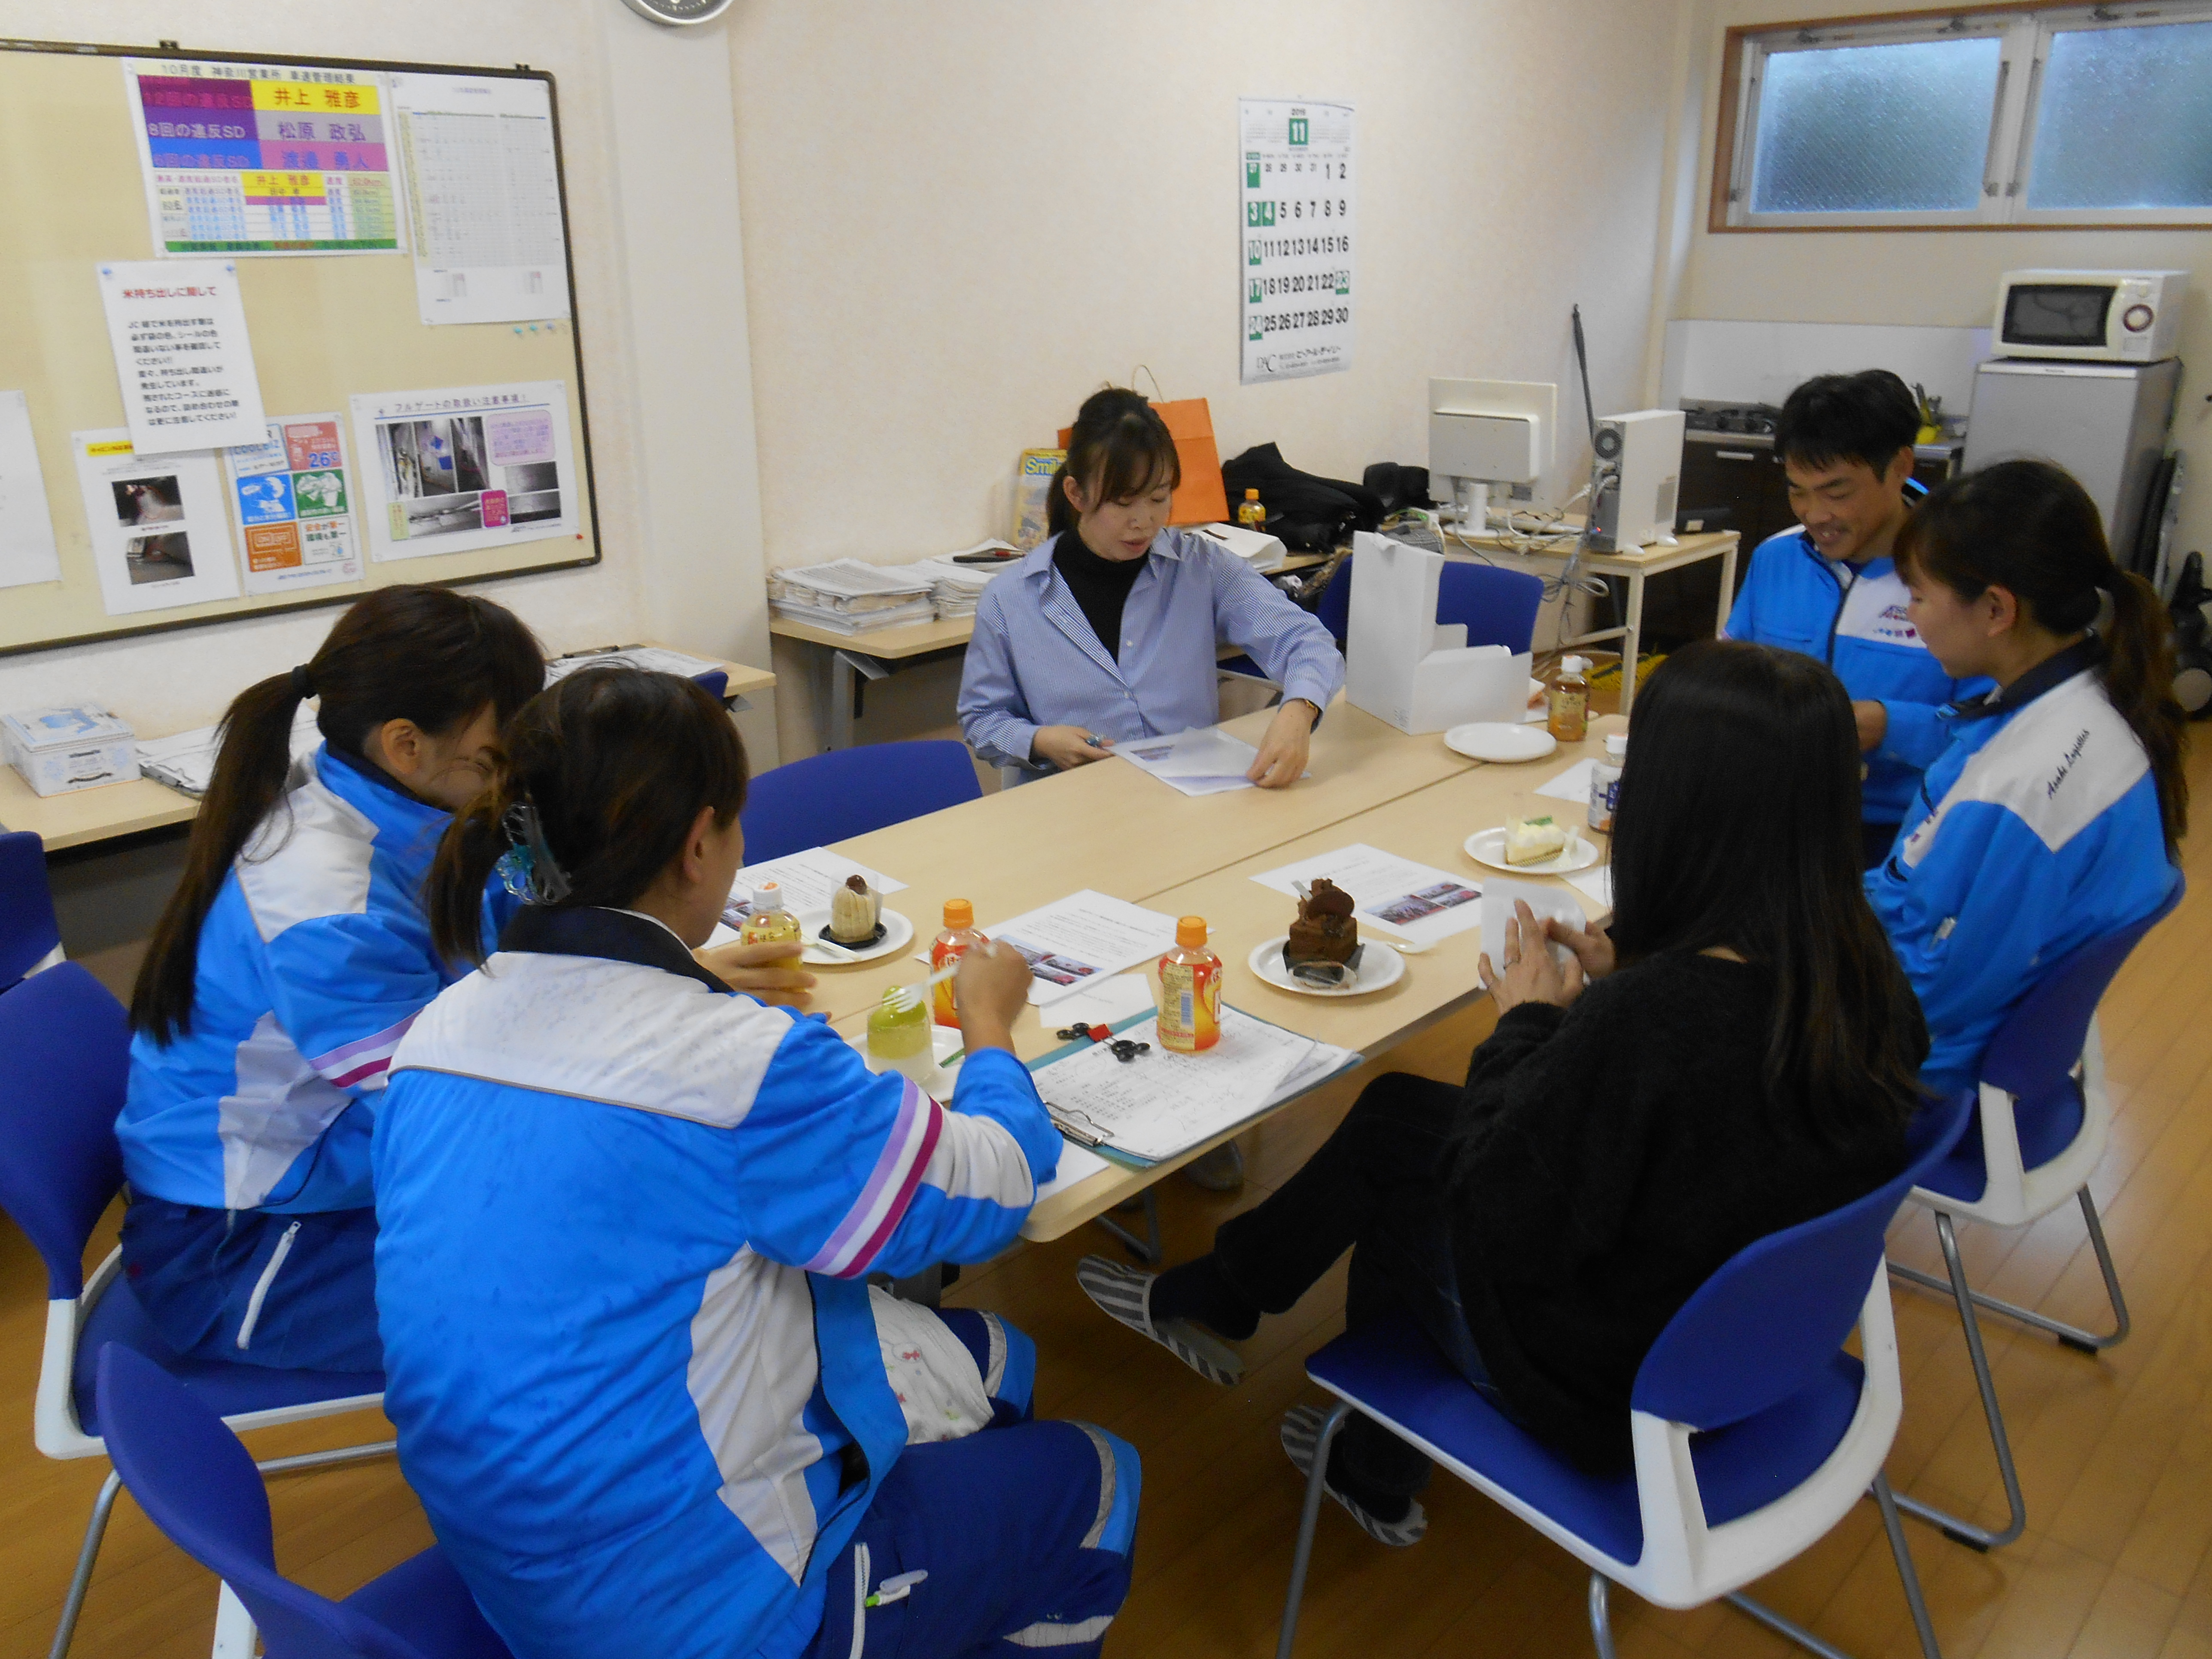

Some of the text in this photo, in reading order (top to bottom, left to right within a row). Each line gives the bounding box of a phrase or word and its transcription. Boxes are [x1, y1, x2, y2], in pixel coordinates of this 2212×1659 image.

[275, 88, 310, 106] 井上
[1292, 122, 1305, 142] 11
[1326, 164, 1330, 179] 1
[1340, 163, 1346, 179] 2
[1250, 200, 1346, 221] 3 4 5 6 7 8 9
[1264, 241, 1274, 257] 11
[1278, 240, 1289, 256] 12
[1293, 238, 1304, 255] 13
[1307, 237, 1319, 254] 14
[1322, 237, 1334, 253] 15
[1337, 236, 1349, 252] 16
[1264, 278, 1276, 295] 18
[1278, 276, 1289, 294] 19
[1293, 276, 1305, 292] 20
[1307, 274, 1319, 291] 21
[1322, 273, 1334, 290] 22
[1264, 315, 1276, 332] 25
[1279, 313, 1291, 331] 26
[1293, 312, 1305, 329] 27
[1308, 310, 1319, 327] 28
[1322, 308, 1334, 325] 29
[1335, 307, 1349, 324] 30
